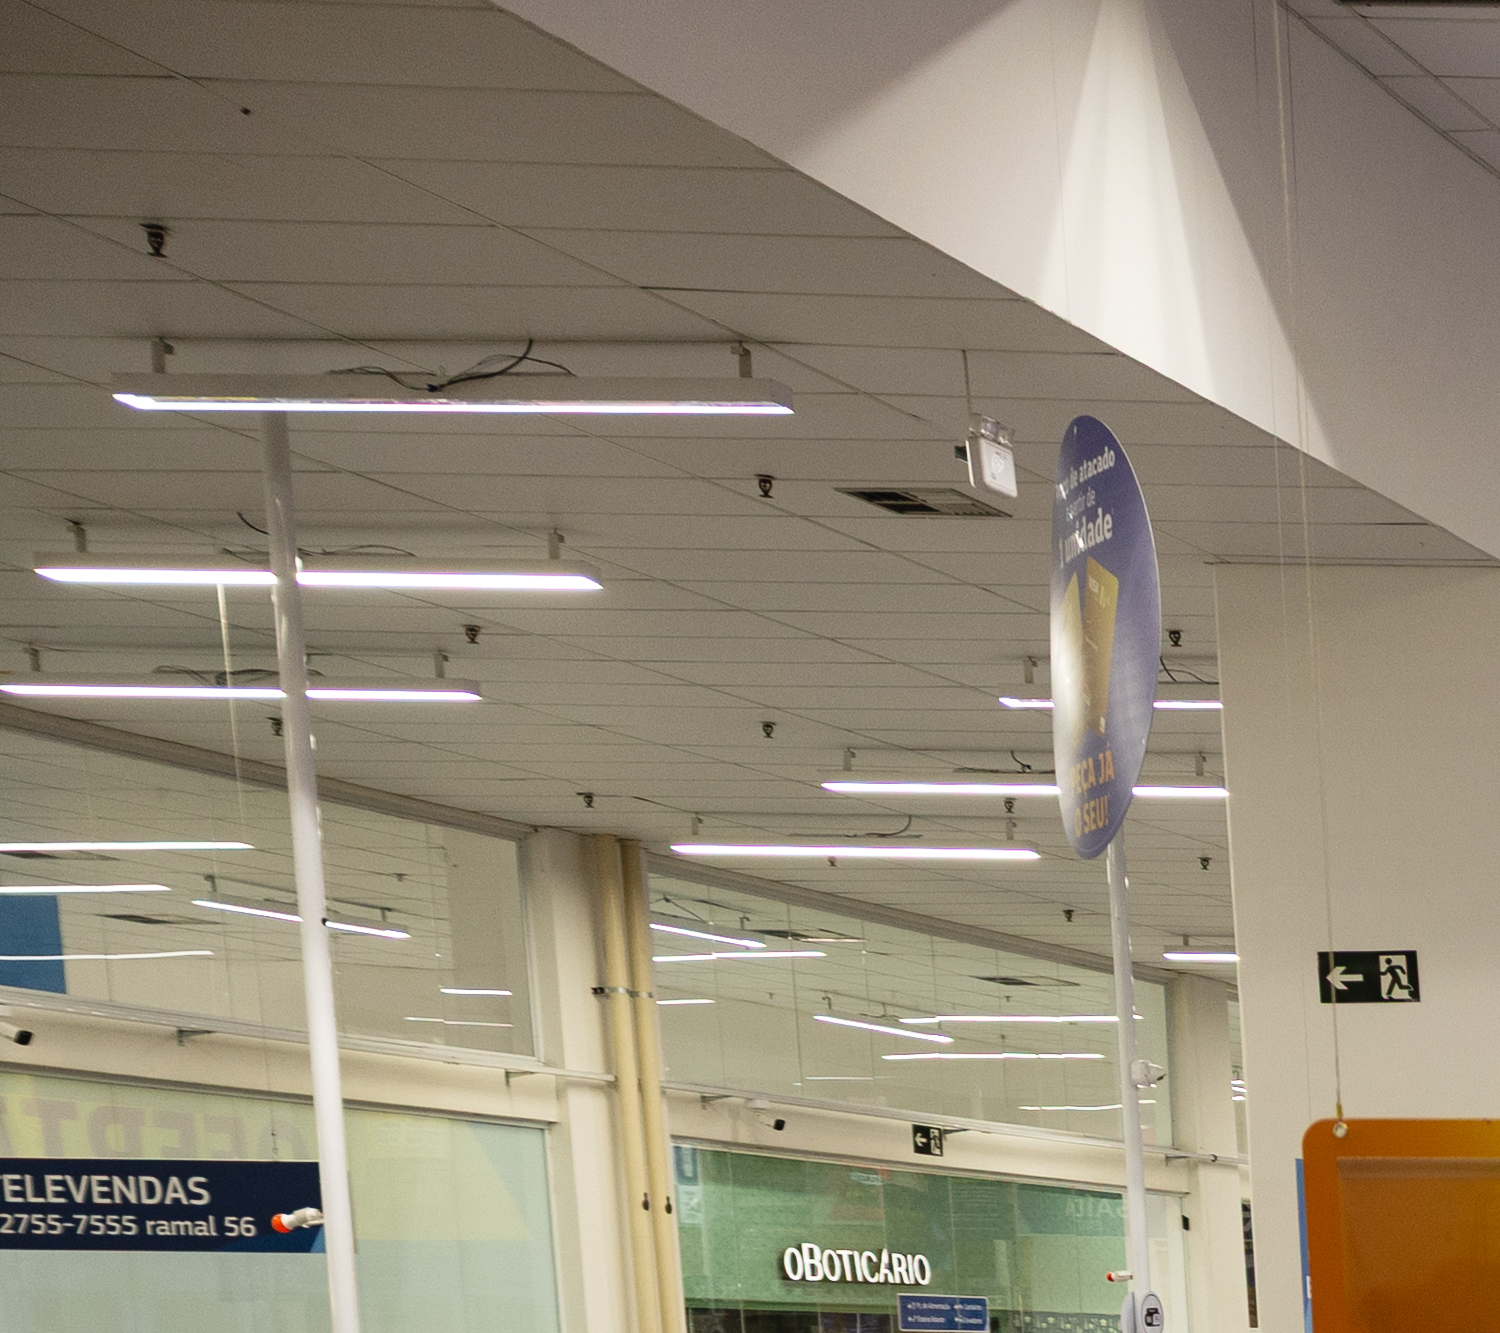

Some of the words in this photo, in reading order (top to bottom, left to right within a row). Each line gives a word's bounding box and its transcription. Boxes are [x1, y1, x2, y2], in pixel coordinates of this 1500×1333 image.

[1078, 446, 1116, 487] atacado
[0, 1174, 211, 1206] ELEVENDAS
[0, 1213, 139, 1236] 2755-7555
[146, 1215, 218, 1236] ramal
[224, 1217, 257, 1237] 56
